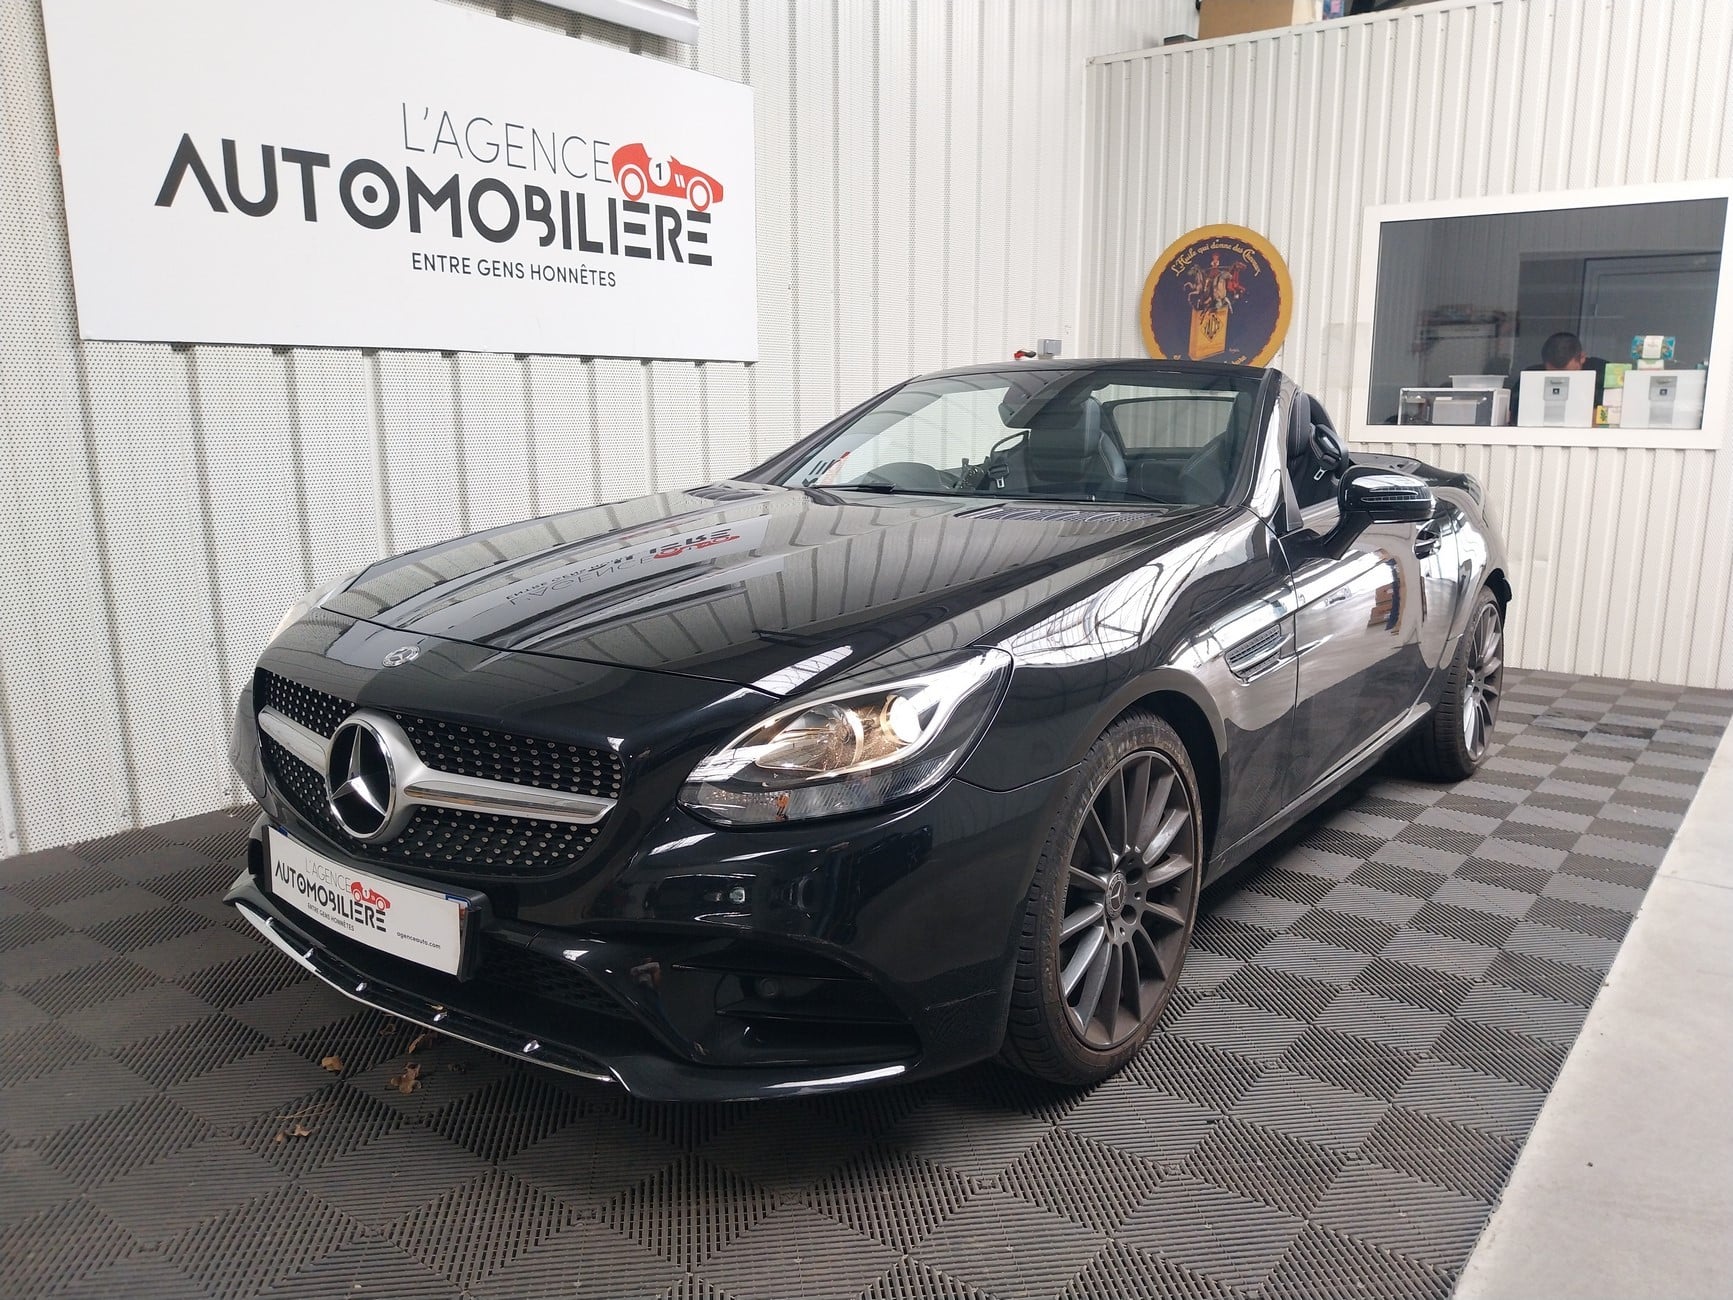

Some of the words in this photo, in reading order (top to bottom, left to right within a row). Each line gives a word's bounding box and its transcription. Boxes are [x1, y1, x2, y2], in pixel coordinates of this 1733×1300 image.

[402, 102, 612, 184] L'AGENCE
[411, 252, 472, 275] ENTRE
[477, 258, 525, 279] GENS
[530, 263, 616, 288] HONNÊTES
[305, 858, 352, 893] L'AGENCE
[396, 931, 441, 949] agenceauto.com
